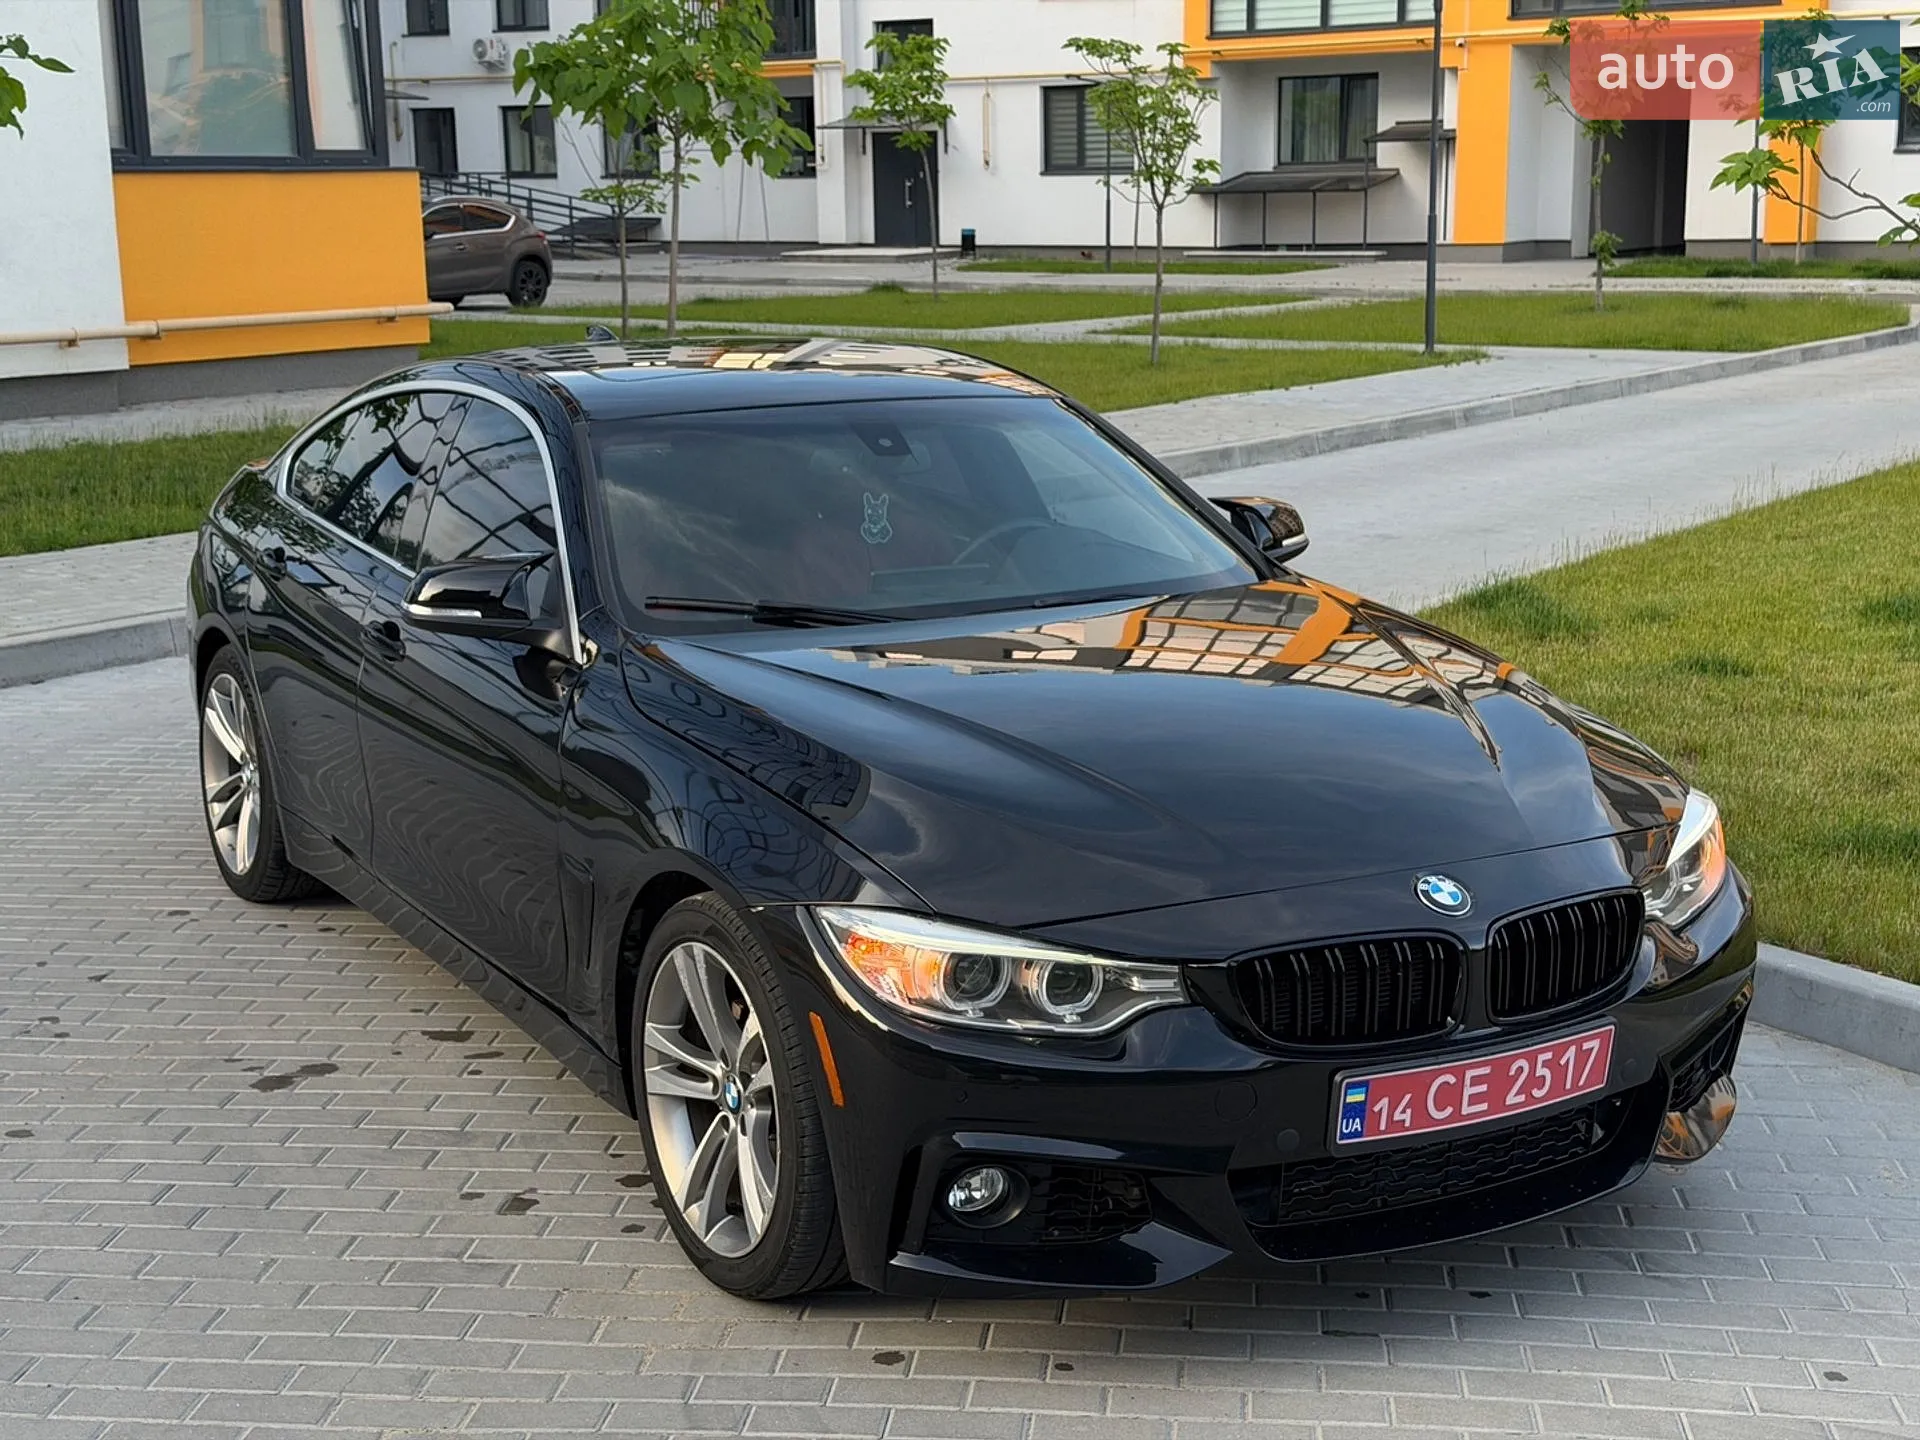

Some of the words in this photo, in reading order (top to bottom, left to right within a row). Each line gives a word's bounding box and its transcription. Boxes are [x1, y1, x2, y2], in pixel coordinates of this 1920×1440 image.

[1372, 1093, 1414, 1131] 14
[1426, 1065, 1492, 1120] CE
[1504, 1038, 1601, 1107] 2517
[1342, 1117, 1362, 1134] UA
